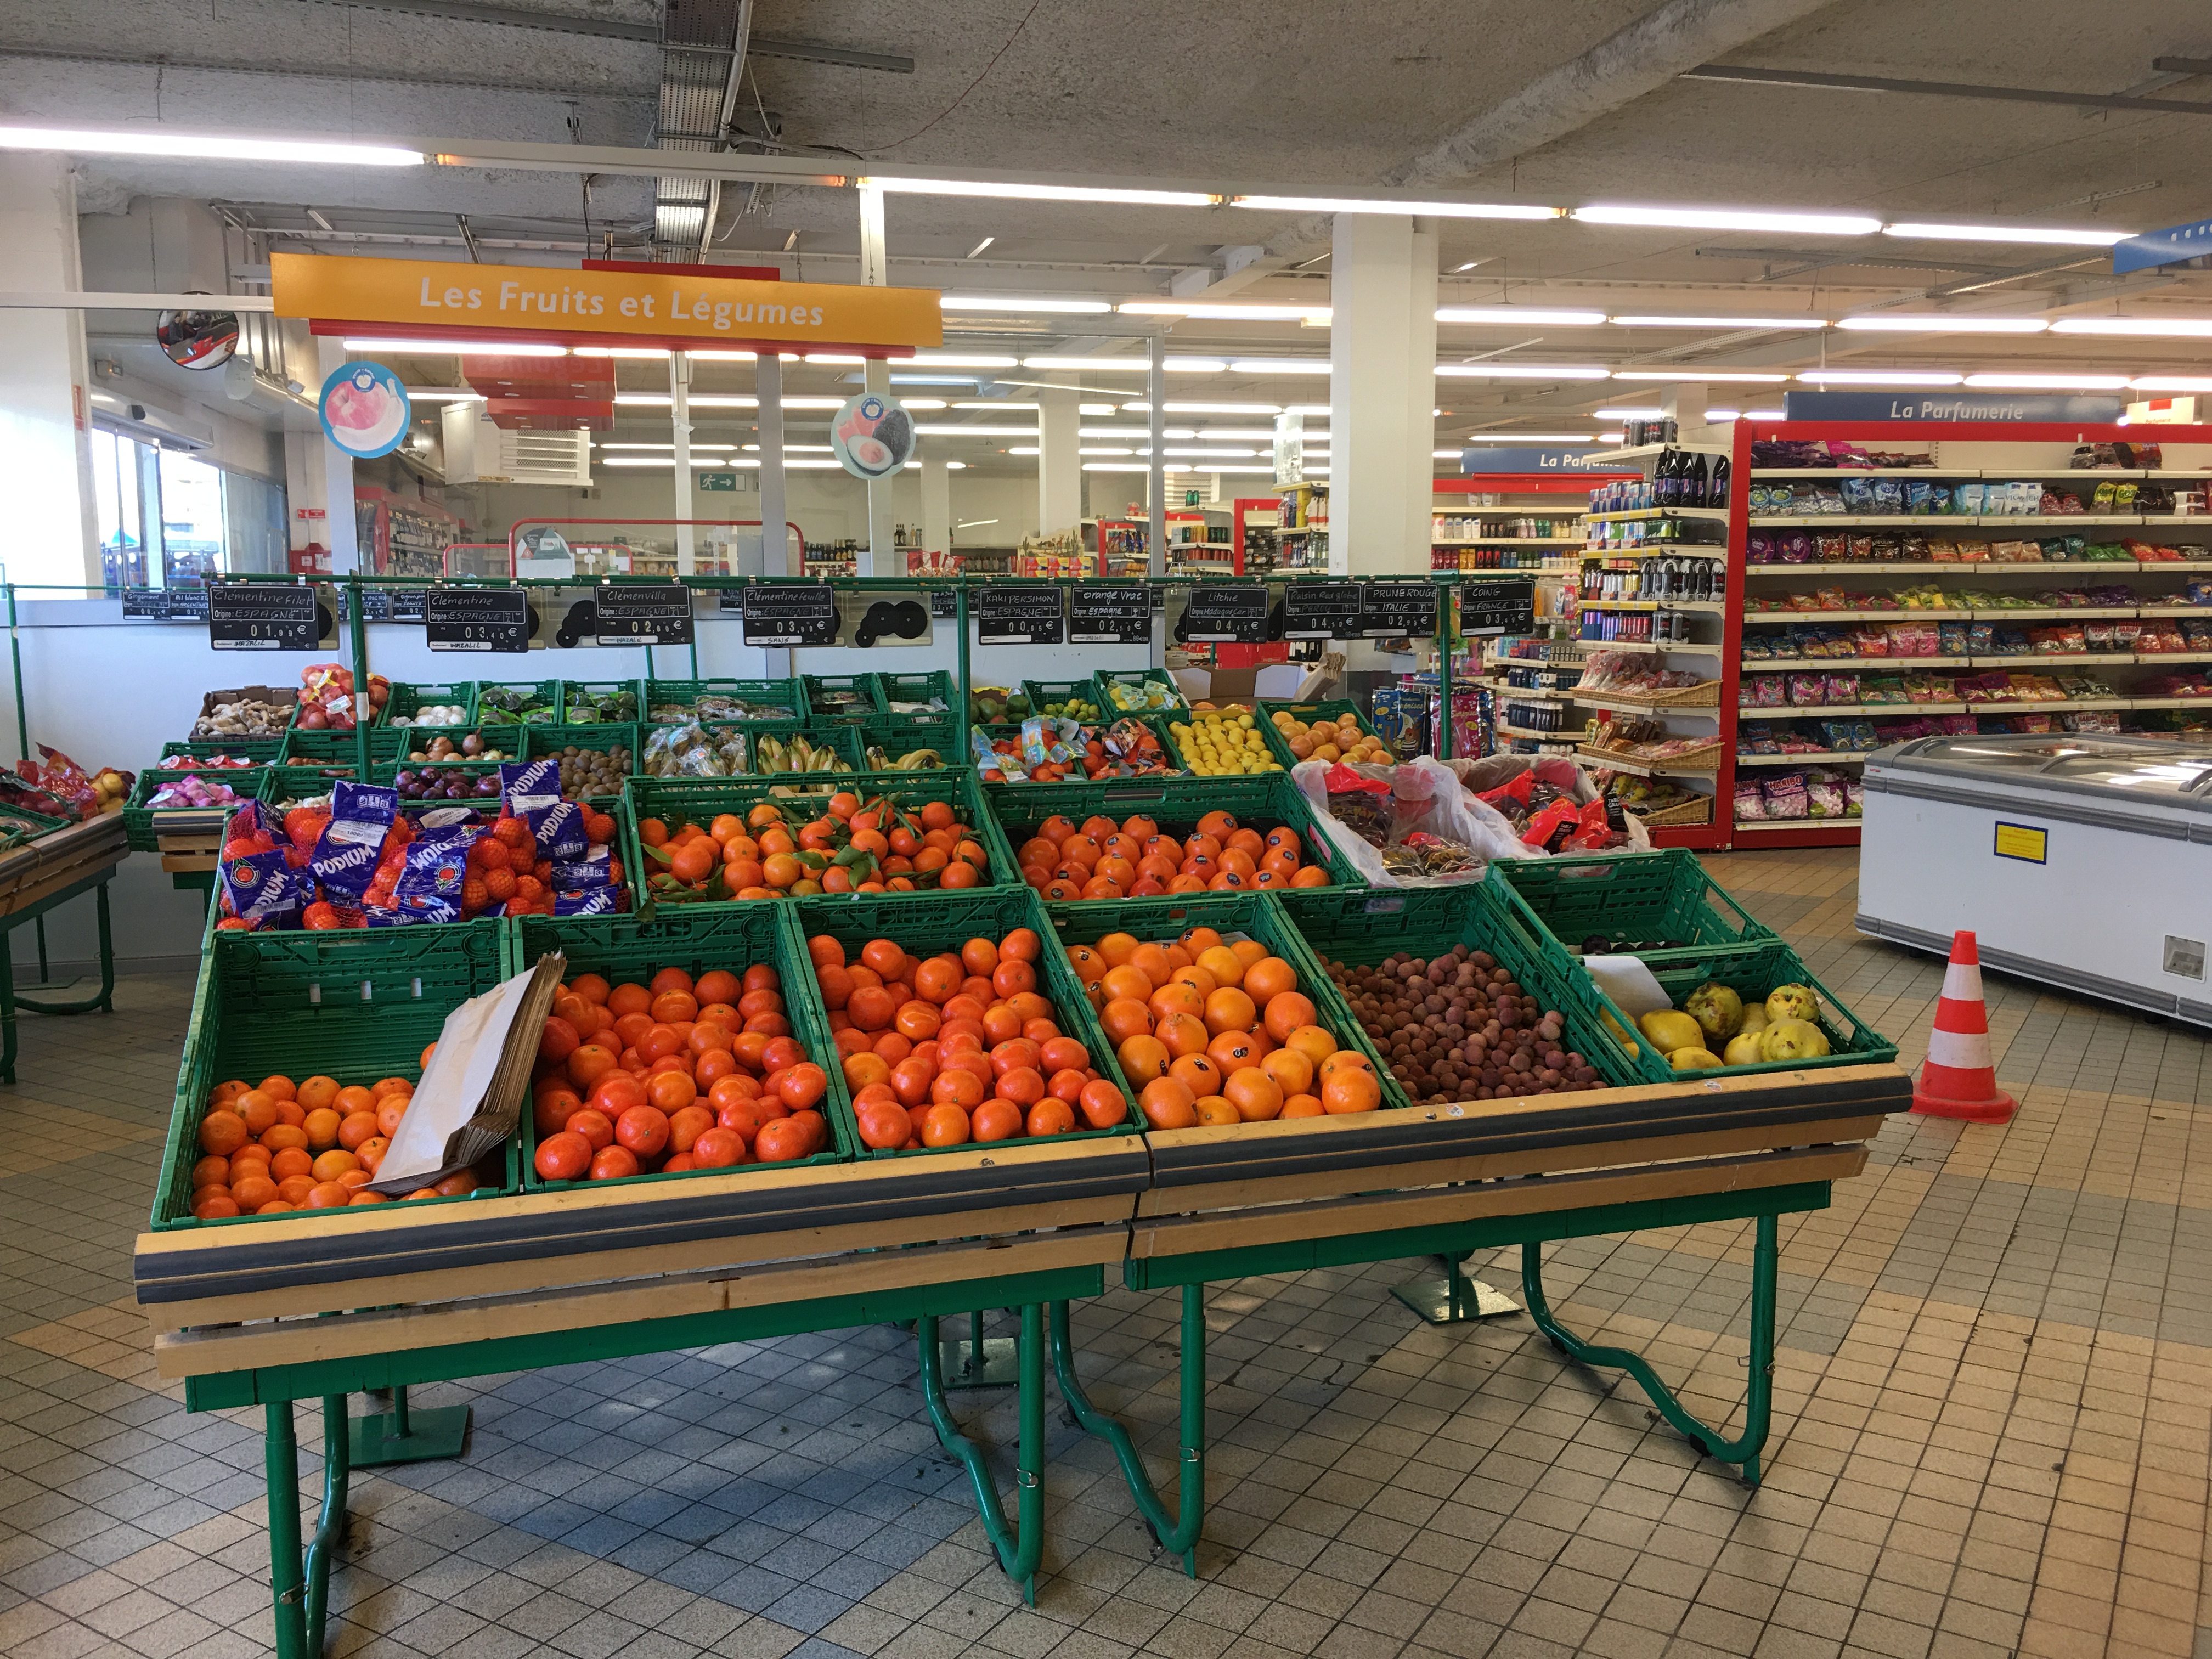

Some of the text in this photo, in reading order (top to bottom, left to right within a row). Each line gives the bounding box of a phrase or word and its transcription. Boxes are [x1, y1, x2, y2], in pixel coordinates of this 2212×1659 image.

[420, 277, 823, 330] Les Fruits et Légumes
[1891, 400, 2023, 422] La Parfumerie
[1540, 454, 1558, 467] La
[214, 590, 283, 602] Clémentine
[607, 588, 667, 601] Clémenvilla
[747, 589, 798, 601] Clémentine
[799, 591, 826, 601] feuille
[1208, 592, 1238, 602] Litchie
[1291, 591, 1357, 602] Raisin Red globe
[1373, 588, 1437, 598] PRUNE ROUGE
[1472, 588, 1501, 596] COING
[432, 594, 493, 605] Clémentine
[1008, 594, 1055, 604] PERSIMON
[618, 607, 667, 616] ESPAGNE
[1301, 605, 1331, 613] PEROU
[1383, 603, 1409, 612] ITALIE
[1476, 602, 1509, 610] FRANCE
[235, 610, 295, 619] ESPAGNE
[449, 612, 501, 621] ESPAGNE
[764, 607, 810, 617] ESPAGNE
[997, 608, 1042, 617] ESPAGNE
[506, 759, 558, 796] PODIUM
[1769, 775, 1803, 791] HARIBO
[535, 802, 573, 845] PODIUM
[312, 845, 377, 877] PODIUM
[409, 842, 453, 871] DIUM
[254, 870, 290, 906] DIUM
